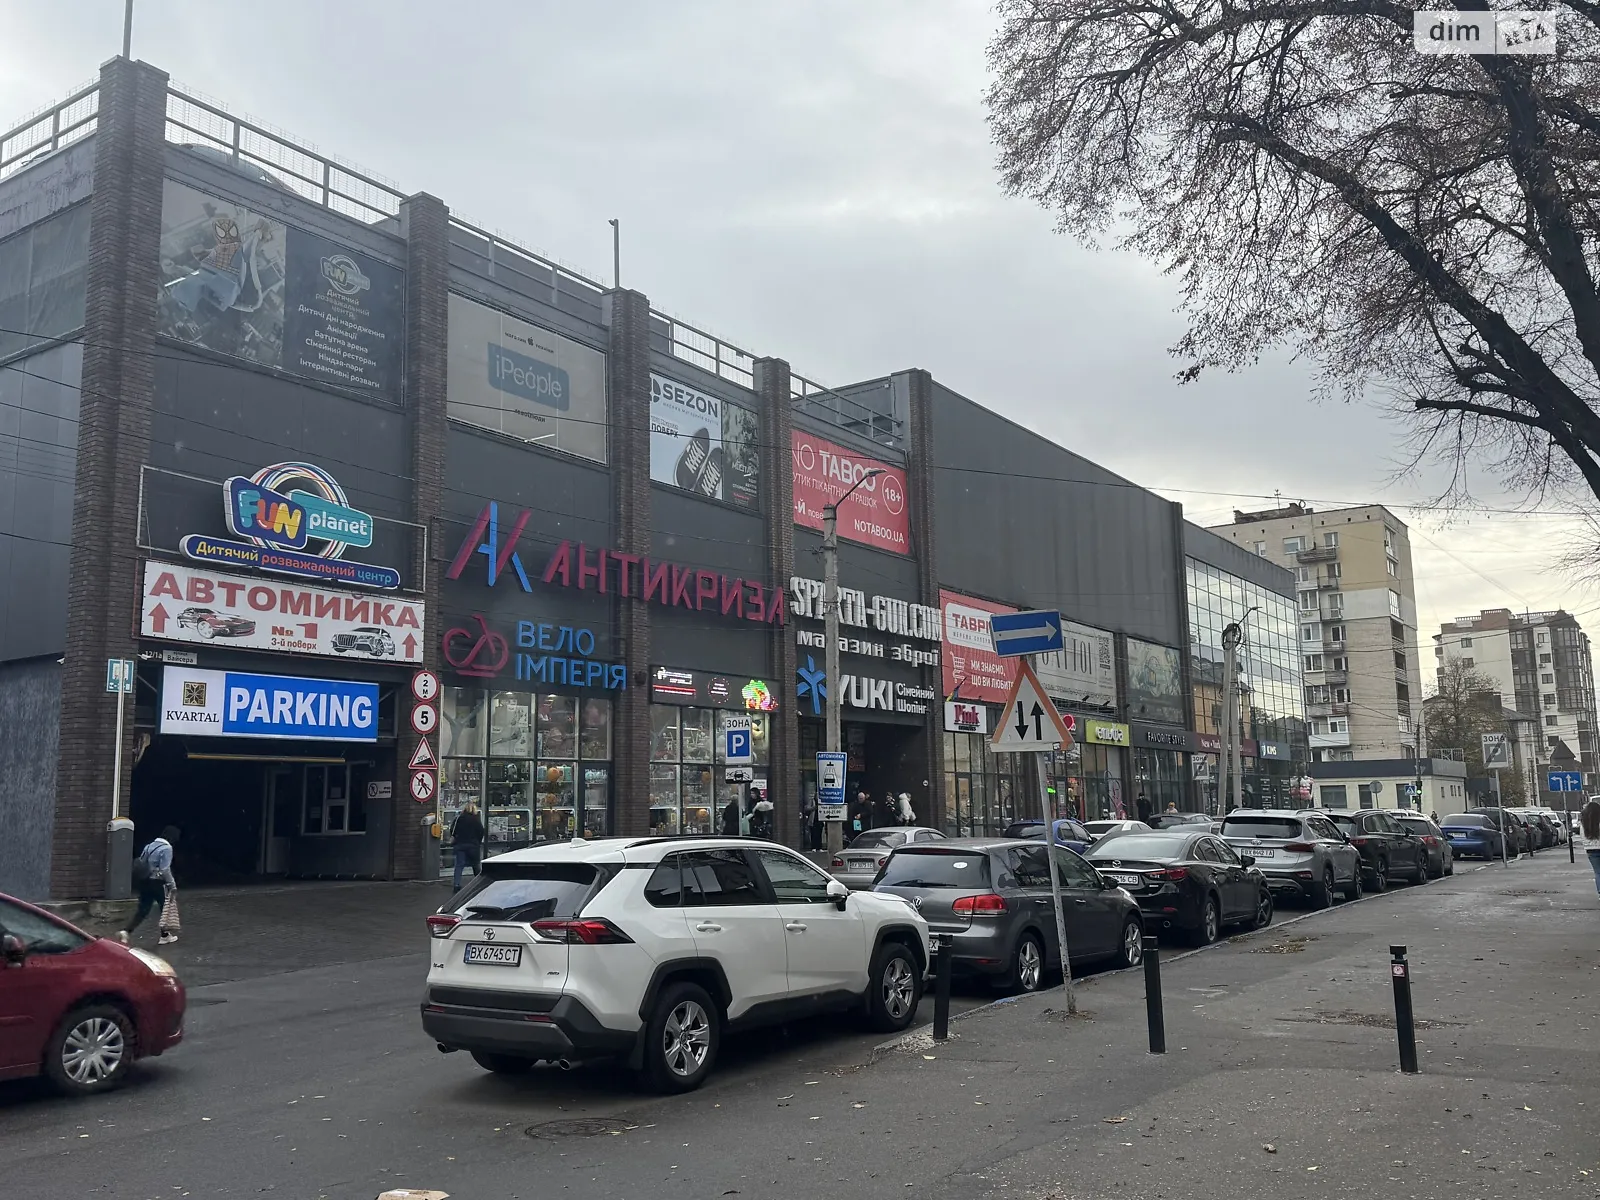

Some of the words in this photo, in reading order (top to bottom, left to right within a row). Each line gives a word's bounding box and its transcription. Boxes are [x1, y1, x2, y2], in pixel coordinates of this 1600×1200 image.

[298, 304, 325, 318] Дитячі
[326, 313, 338, 323] Дні
[340, 320, 385, 339] народження
[315, 330, 345, 347] Батутна
[347, 342, 368, 354] арена
[327, 324, 358, 340] Анімації
[318, 353, 364, 373] Ніндзя-парк
[343, 351, 376, 367] ресторан
[300, 358, 349, 379] Інтерактивні
[350, 375, 380, 388] розваги
[663, 383, 718, 417] SEZON
[651, 423, 678, 438] ПОВЕРХ
[792, 472, 812, 487] УТИК
[884, 487, 901, 502] 18+
[238, 489, 302, 540] FUN
[309, 511, 367, 535] planet
[794, 498, 806, 515] -Й
[807, 509, 824, 519] пове
[854, 519, 905, 544] NOTABOO.UA
[196, 541, 259, 562] Дитячий
[261, 555, 355, 578] розважальний
[357, 569, 392, 585] центр
[543, 538, 785, 626] АНТИКРИЗА
[149, 572, 421, 629] АВТОМИЙКА
[296, 622, 318, 640] 1
[952, 613, 989, 634] ТАВРІ
[271, 638, 286, 648] 3-й
[287, 639, 317, 651] поверх
[517, 620, 595, 656] ВЕЛО
[797, 630, 884, 658] маазин
[891, 643, 939, 668] зброї
[516, 653, 627, 691] ІМПЕРІЯ
[971, 660, 980, 672] МИ
[981, 661, 1006, 676] ЗНАЄМО,
[896, 682, 935, 700] Сімейний
[971, 675, 982, 686] ЩО
[983, 676, 990, 687] ВИ
[839, 674, 894, 711] YUKI
[166, 710, 220, 723] KVARTAL
[229, 686, 372, 729] PARKING
[420, 711, 429, 725] 5
[726, 719, 750, 728] ЗОНА
[732, 734, 745, 754] P
[1147, 731, 1172, 744] FAVORITE
[1172, 734, 1186, 746] STYLE
[470, 945, 484, 959] BX
[484, 946, 504, 961] 6745
[505, 948, 518, 963] CT
